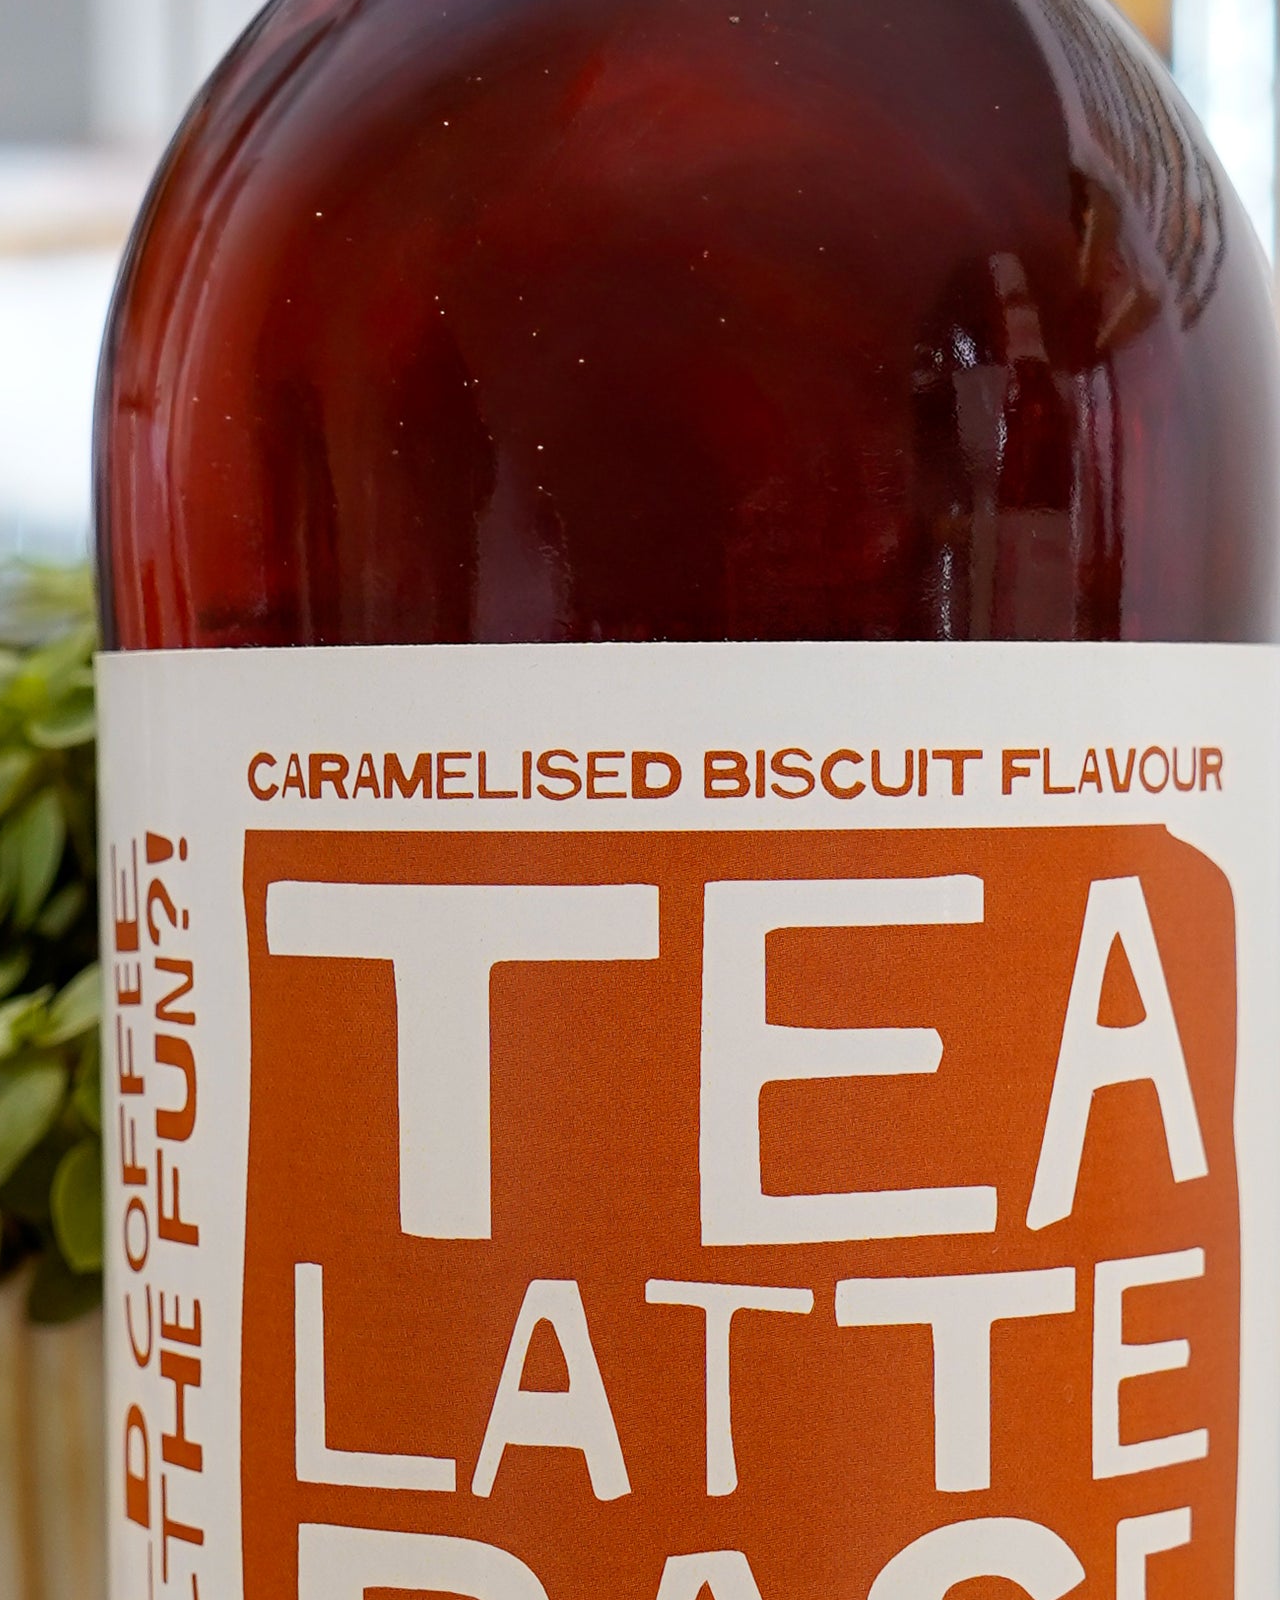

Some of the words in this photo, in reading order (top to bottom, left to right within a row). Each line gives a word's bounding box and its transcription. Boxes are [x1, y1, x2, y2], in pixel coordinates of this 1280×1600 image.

[246, 750, 683, 800] CARAMELISED
[703, 748, 984, 798] BISCUIT
[1000, 746, 1225, 795] FLAVOUR
[111, 841, 153, 1369] COFFEE
[145, 830, 200, 1247] FUN?!
[266, 872, 1210, 1247] TEA
[158, 1289, 204, 1584] THE
[294, 1247, 1210, 1502] LATTE
